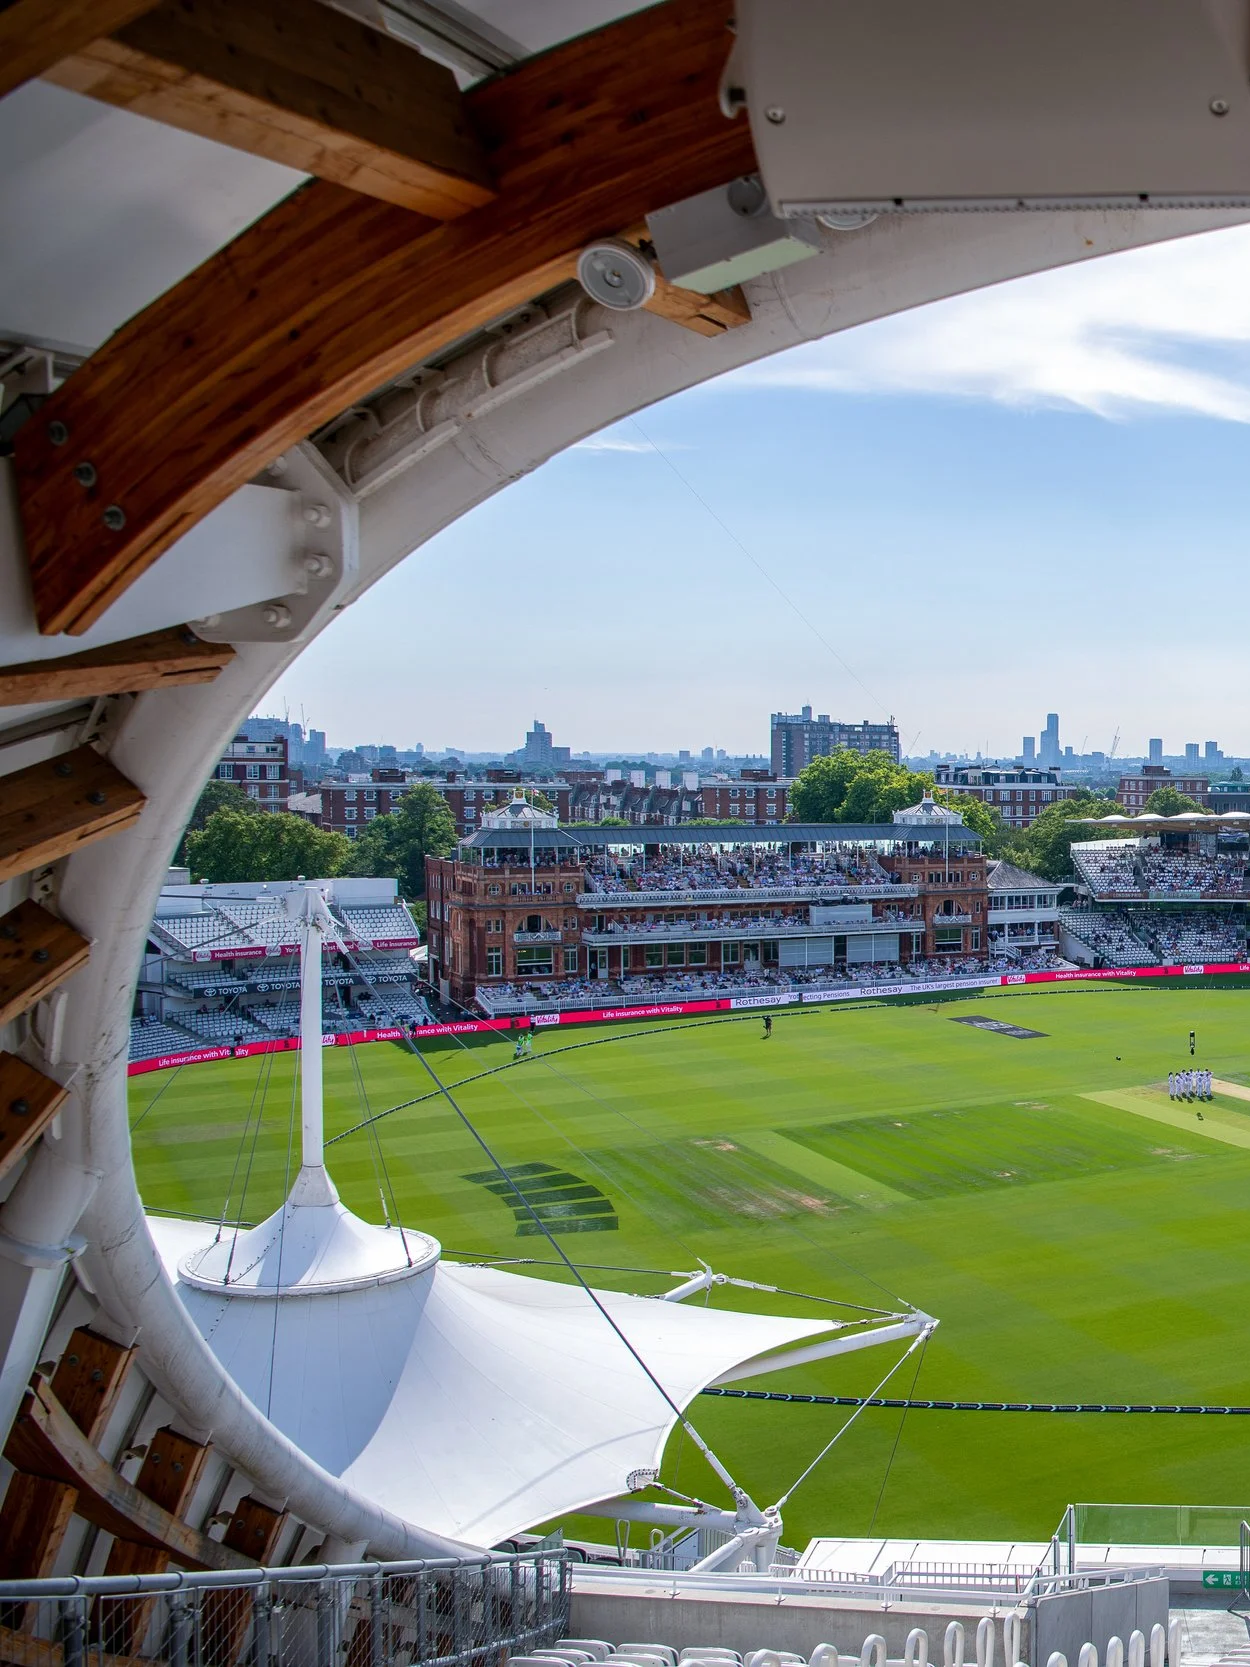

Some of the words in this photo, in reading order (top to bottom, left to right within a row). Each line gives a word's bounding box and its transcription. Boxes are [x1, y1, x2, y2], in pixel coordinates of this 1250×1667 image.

[325, 978, 354, 986] TOYOTA
[378, 975, 408, 983] TOYOTA
[218, 986, 248, 995] TOYOTA
[270, 982, 300, 990] TOYOTA
[860, 986, 903, 995] Rothesay
[955, 980, 978, 988] pension
[735, 996, 782, 1006] Rothesay
[823, 991, 850, 999] Pensions
[661, 1006, 683, 1014] Vitality
[377, 1029, 400, 1038] Health
[436, 1025, 452, 1033] with
[452, 1023, 478, 1032] Vitality
[158, 1058, 170, 1066] Life
[203, 1050, 219, 1058] with
